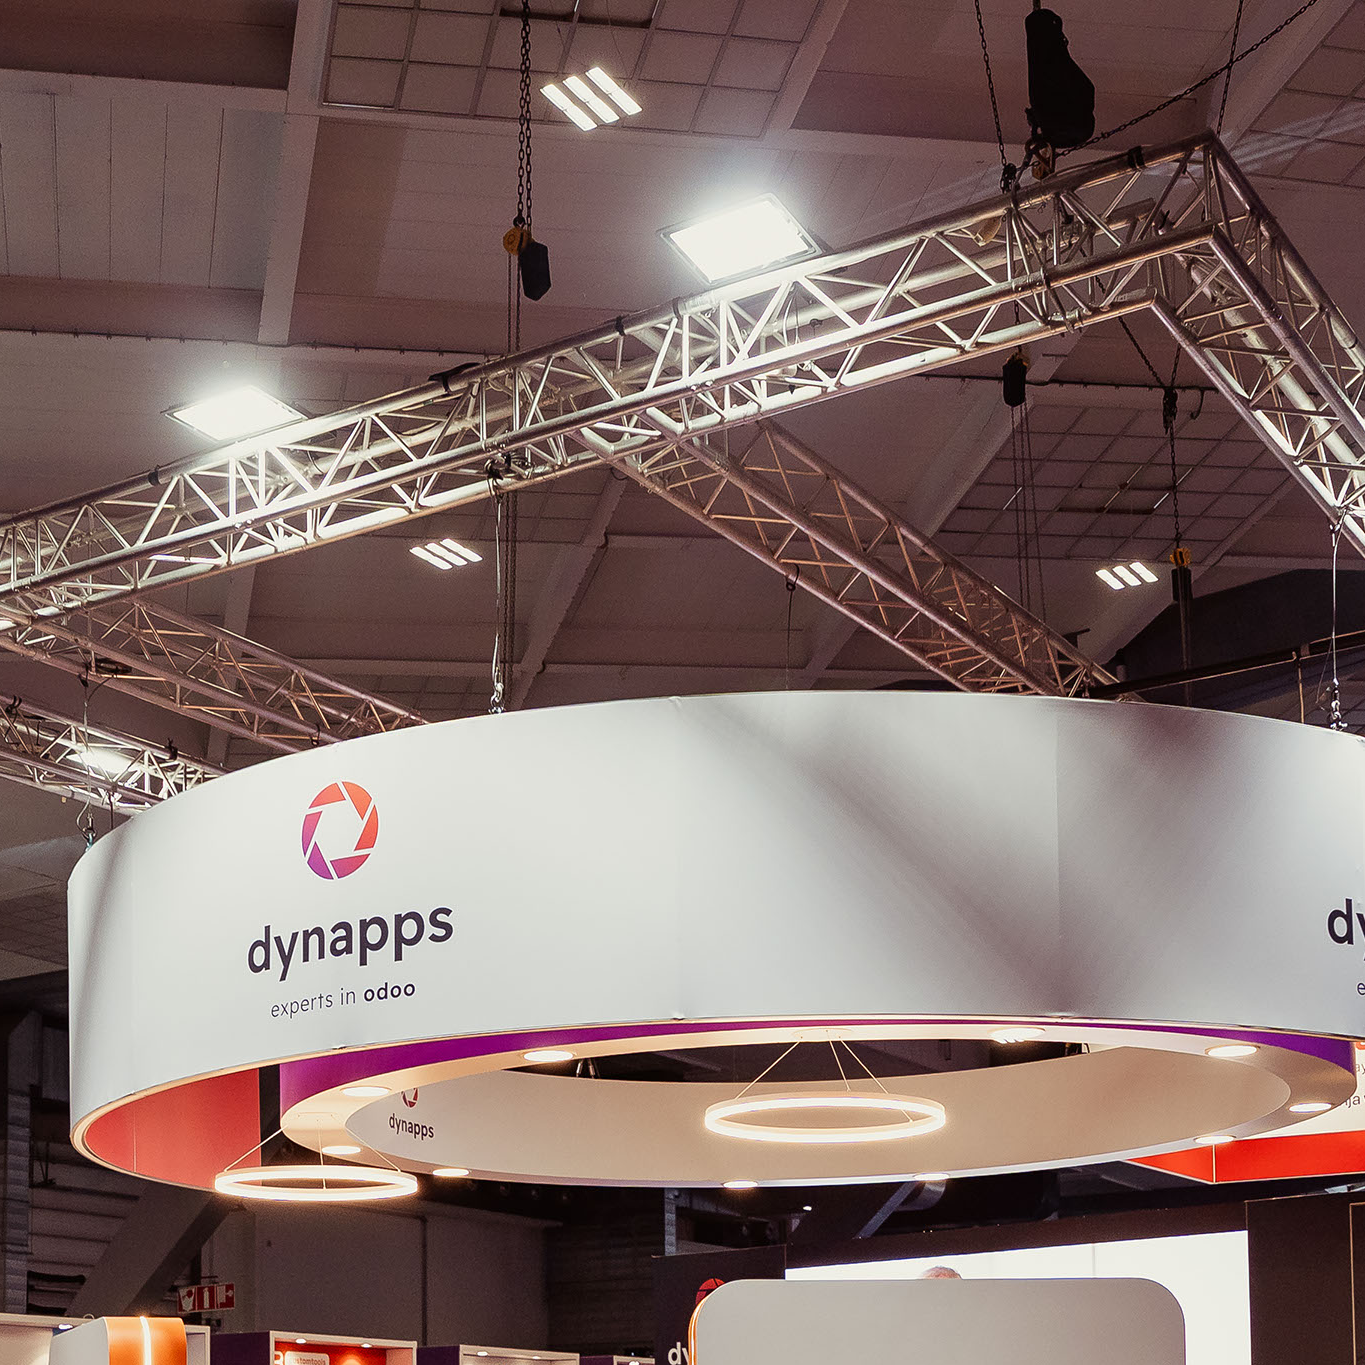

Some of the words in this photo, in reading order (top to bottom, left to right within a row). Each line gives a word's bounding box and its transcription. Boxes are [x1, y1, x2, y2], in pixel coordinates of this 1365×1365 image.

[247, 906, 454, 982] dynapps
[270, 993, 334, 1019] experts
[340, 987, 356, 1006] in
[363, 982, 416, 1002] odoo
[388, 1112, 435, 1141] dynapps
